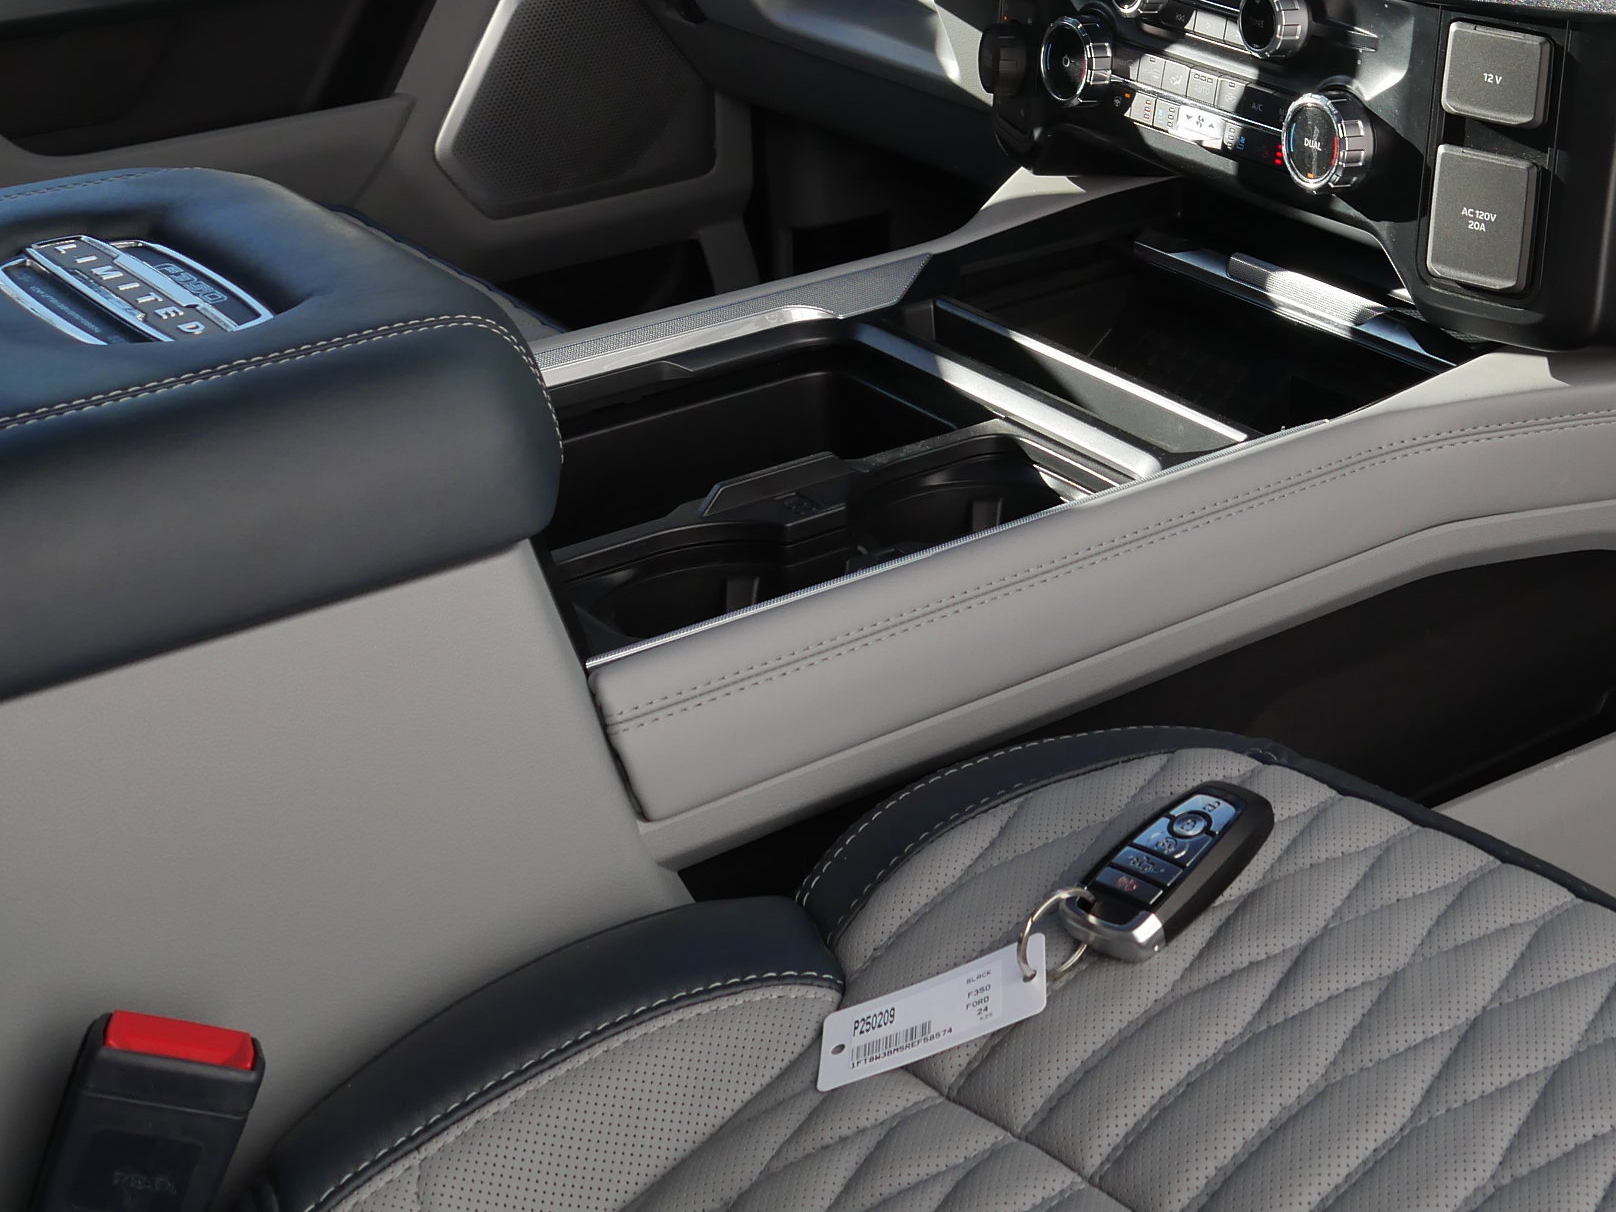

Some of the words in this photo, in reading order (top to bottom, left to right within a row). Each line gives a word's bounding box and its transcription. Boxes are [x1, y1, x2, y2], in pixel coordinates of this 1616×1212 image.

[1483, 73, 1494, 84] 12
[1251, 100, 1264, 112] A/C
[1303, 136, 1322, 152] DUAL
[1461, 206, 1475, 218] AC
[1475, 208, 1498, 222] 120V
[1467, 220, 1487, 232] 20A
[53, 241, 207, 337] LIMITED
[967, 984, 992, 999] F350
[966, 995, 990, 1011] FORD
[977, 1005, 989, 1016] 24
[852, 1006, 896, 1037] P250209
